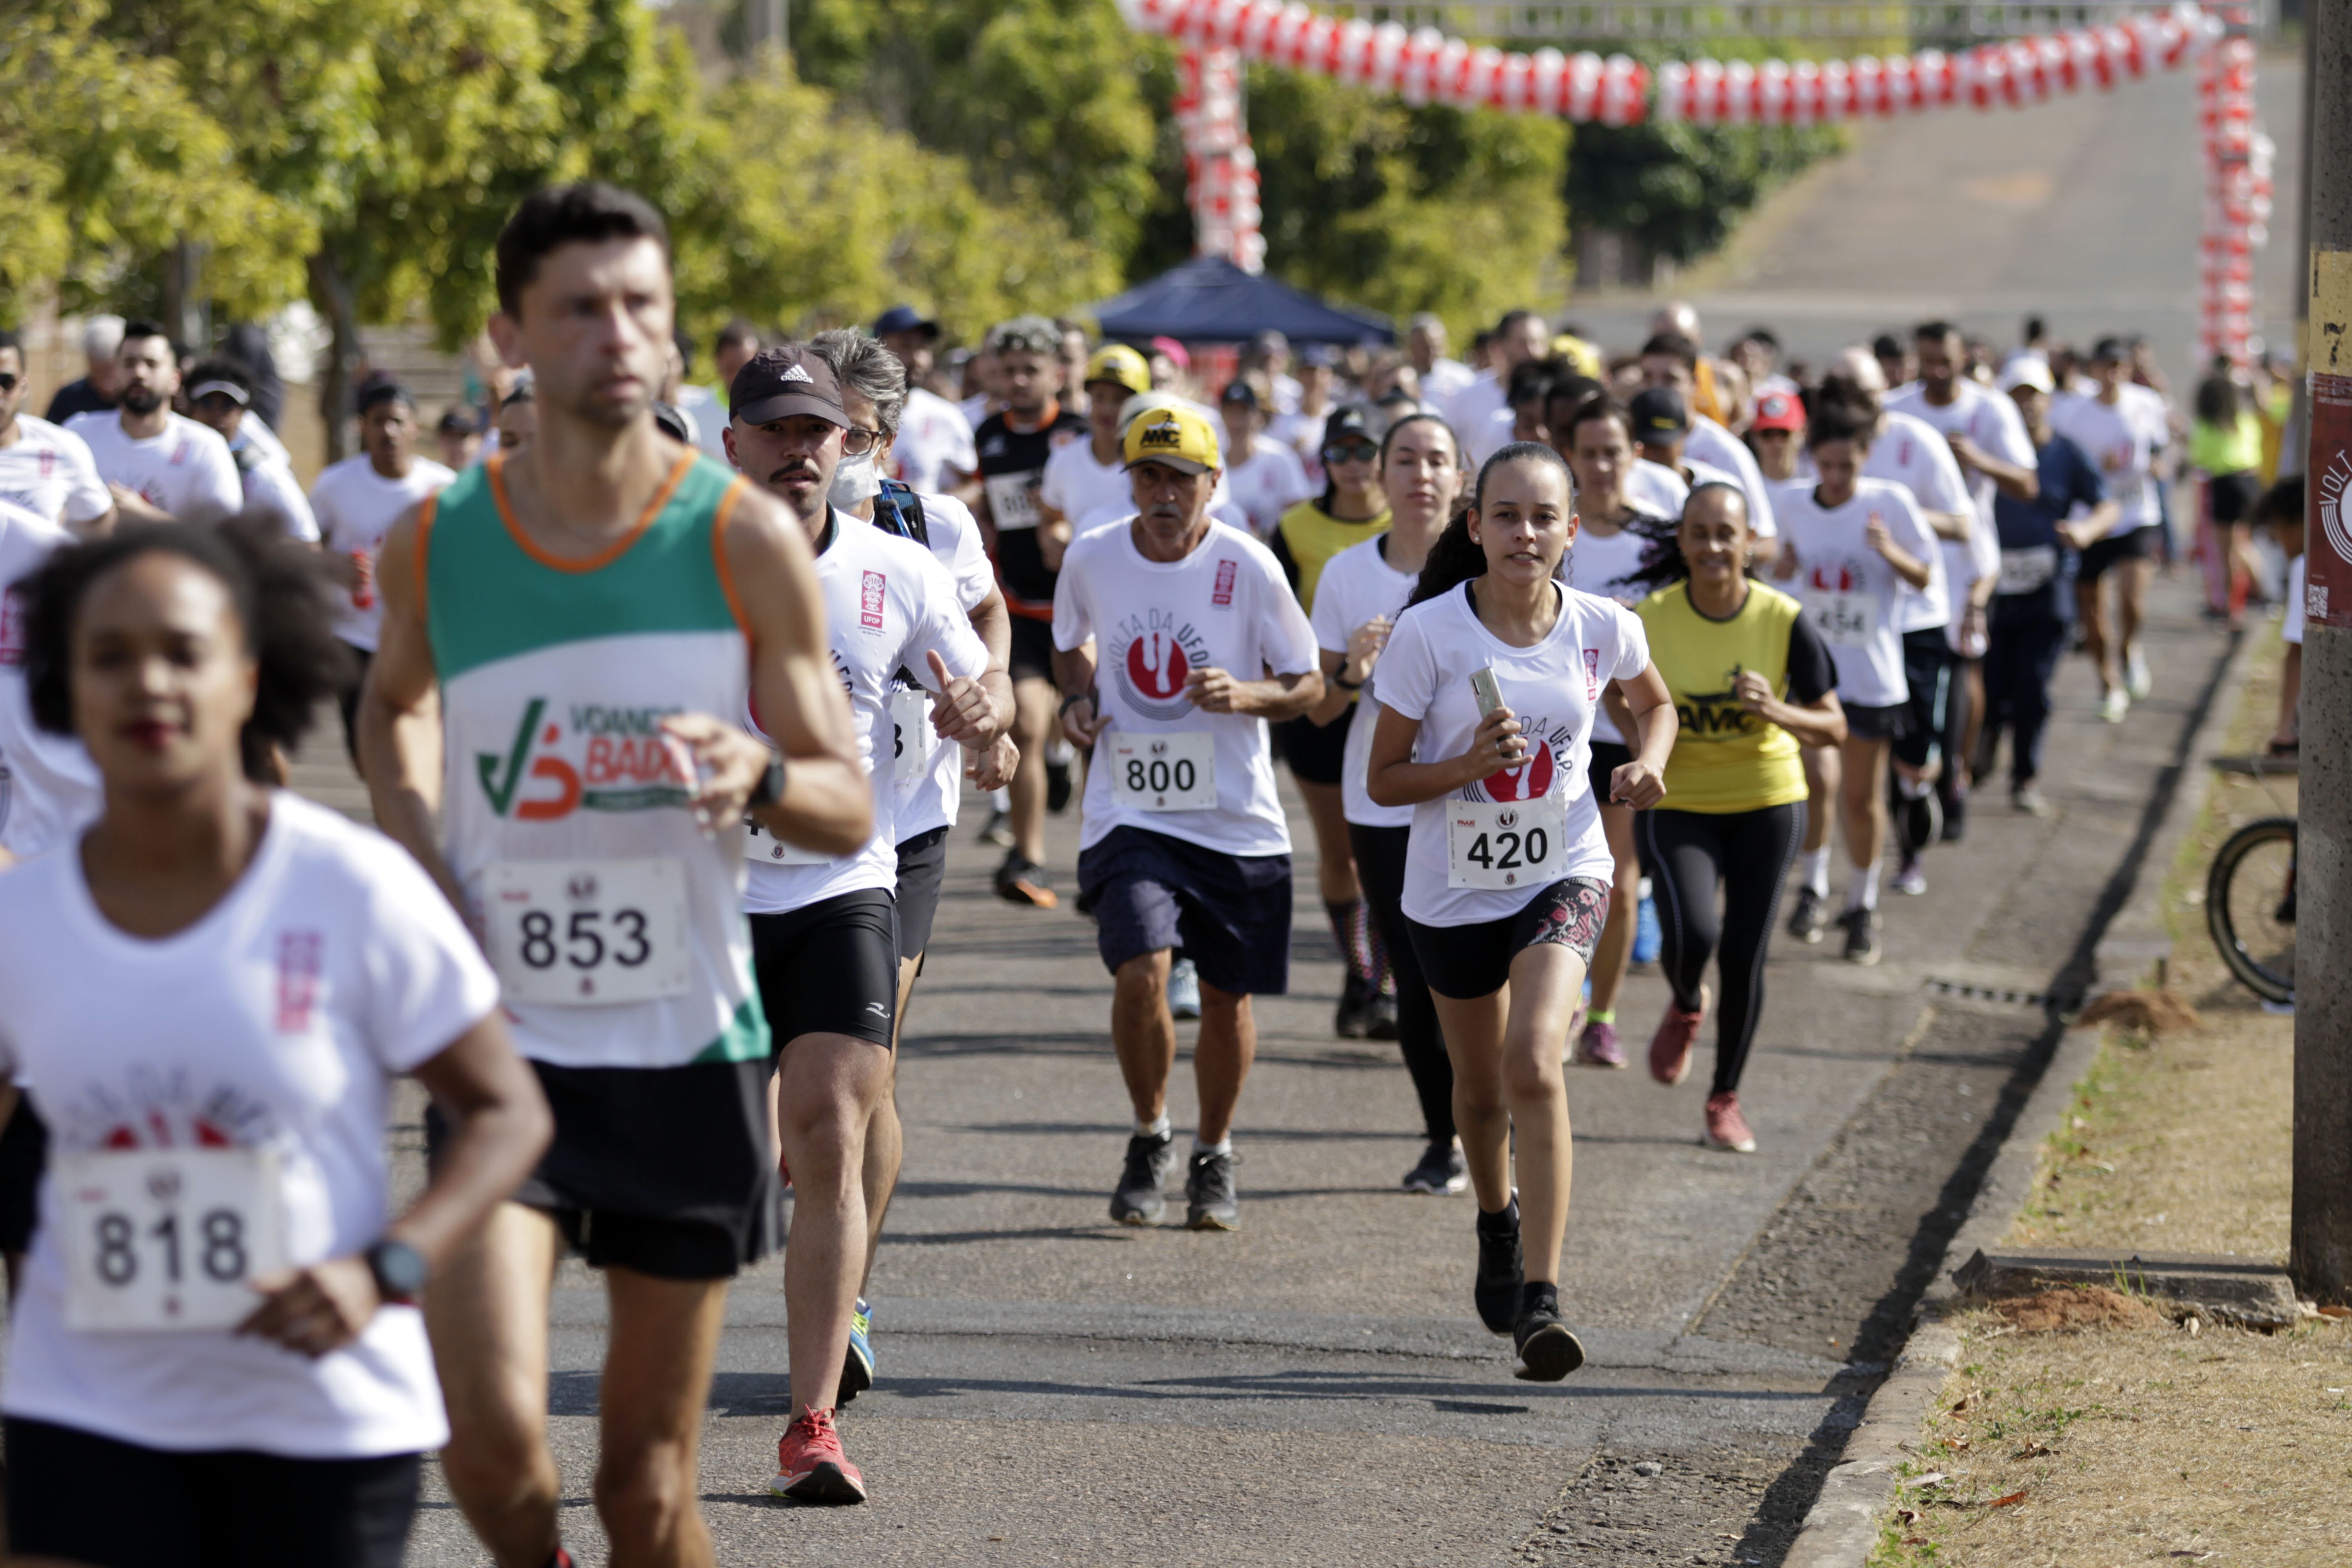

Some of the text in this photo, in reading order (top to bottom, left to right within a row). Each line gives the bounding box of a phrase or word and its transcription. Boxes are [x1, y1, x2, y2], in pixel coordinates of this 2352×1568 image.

[781, 374, 813, 383] adidas
[1139, 428, 1180, 444] AMC
[864, 615, 880, 624] UFOP
[1107, 607, 1211, 669] VOLTA DA UFO
[1520, 716, 1547, 735] DA
[1127, 759, 1196, 792] 800
[1467, 828, 1548, 869] 420
[520, 909, 651, 969] 853
[96, 1208, 247, 1287] 818
